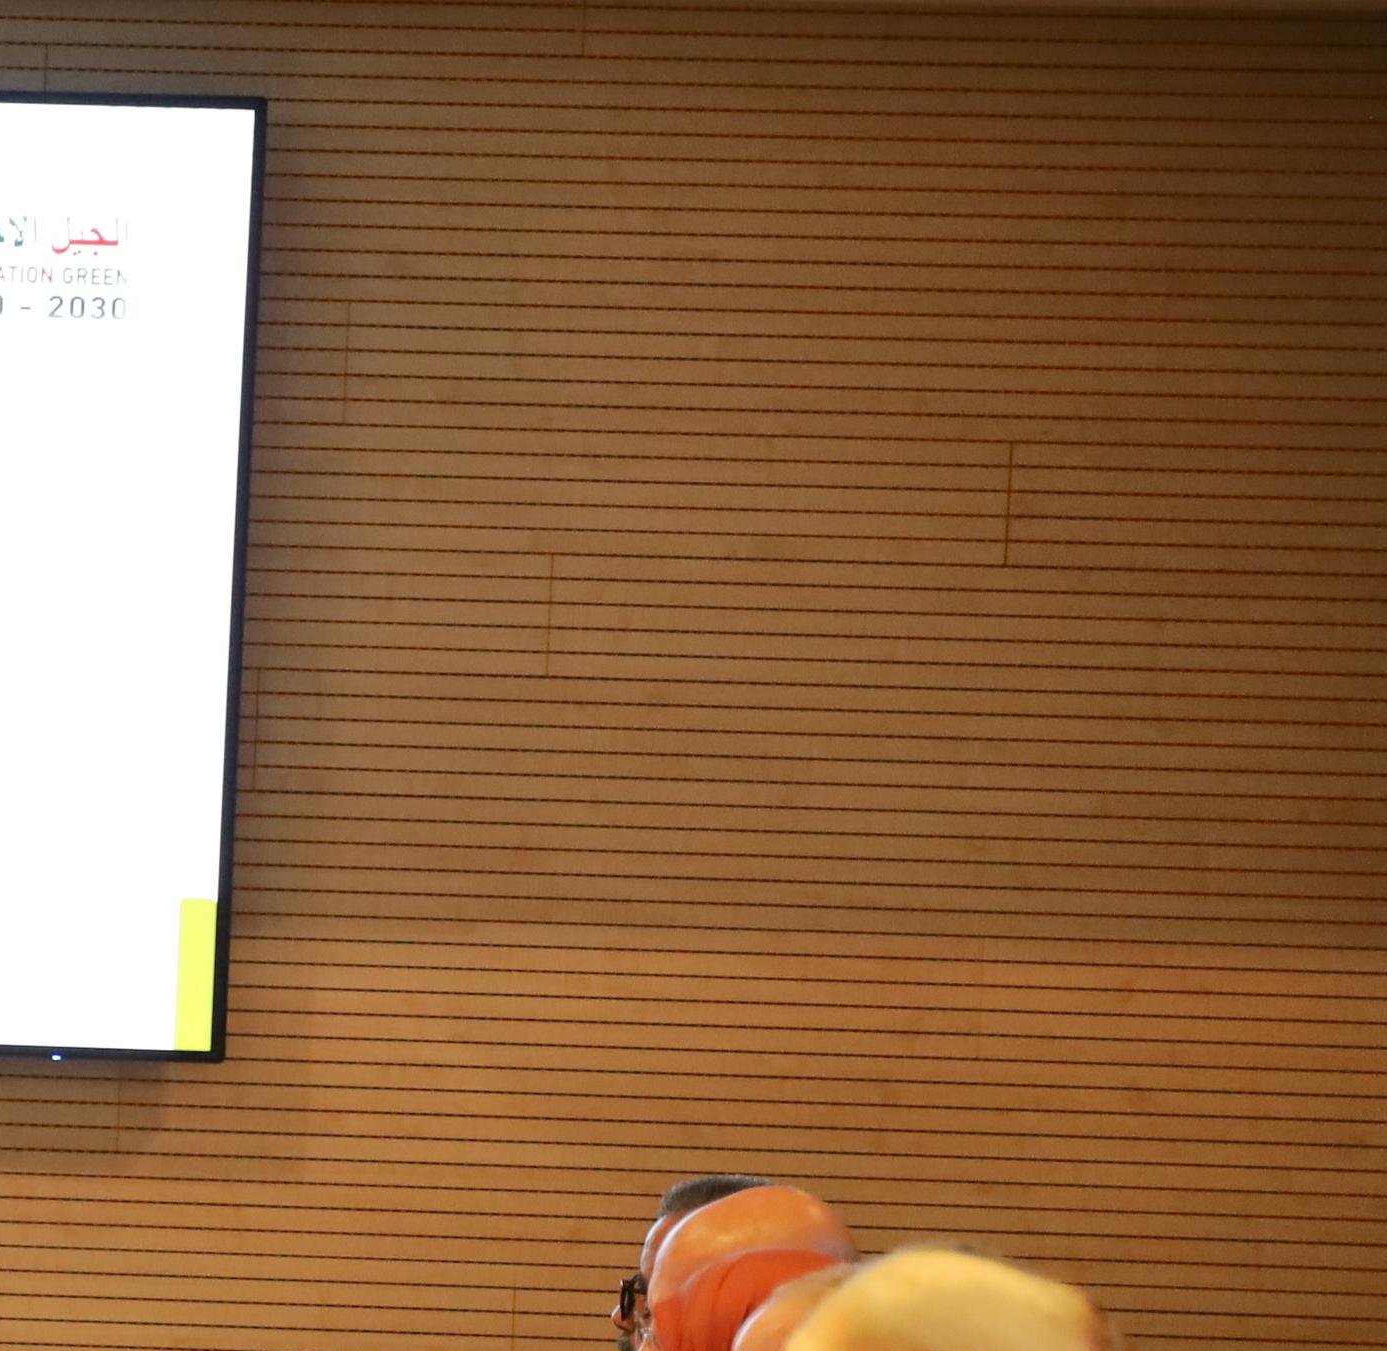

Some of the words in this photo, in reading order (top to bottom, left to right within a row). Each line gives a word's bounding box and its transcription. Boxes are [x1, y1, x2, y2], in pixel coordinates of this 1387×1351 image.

[52, 217, 130, 257] الجيل
[62, 267, 130, 286] GREEN
[47, 295, 127, 321] 2030
